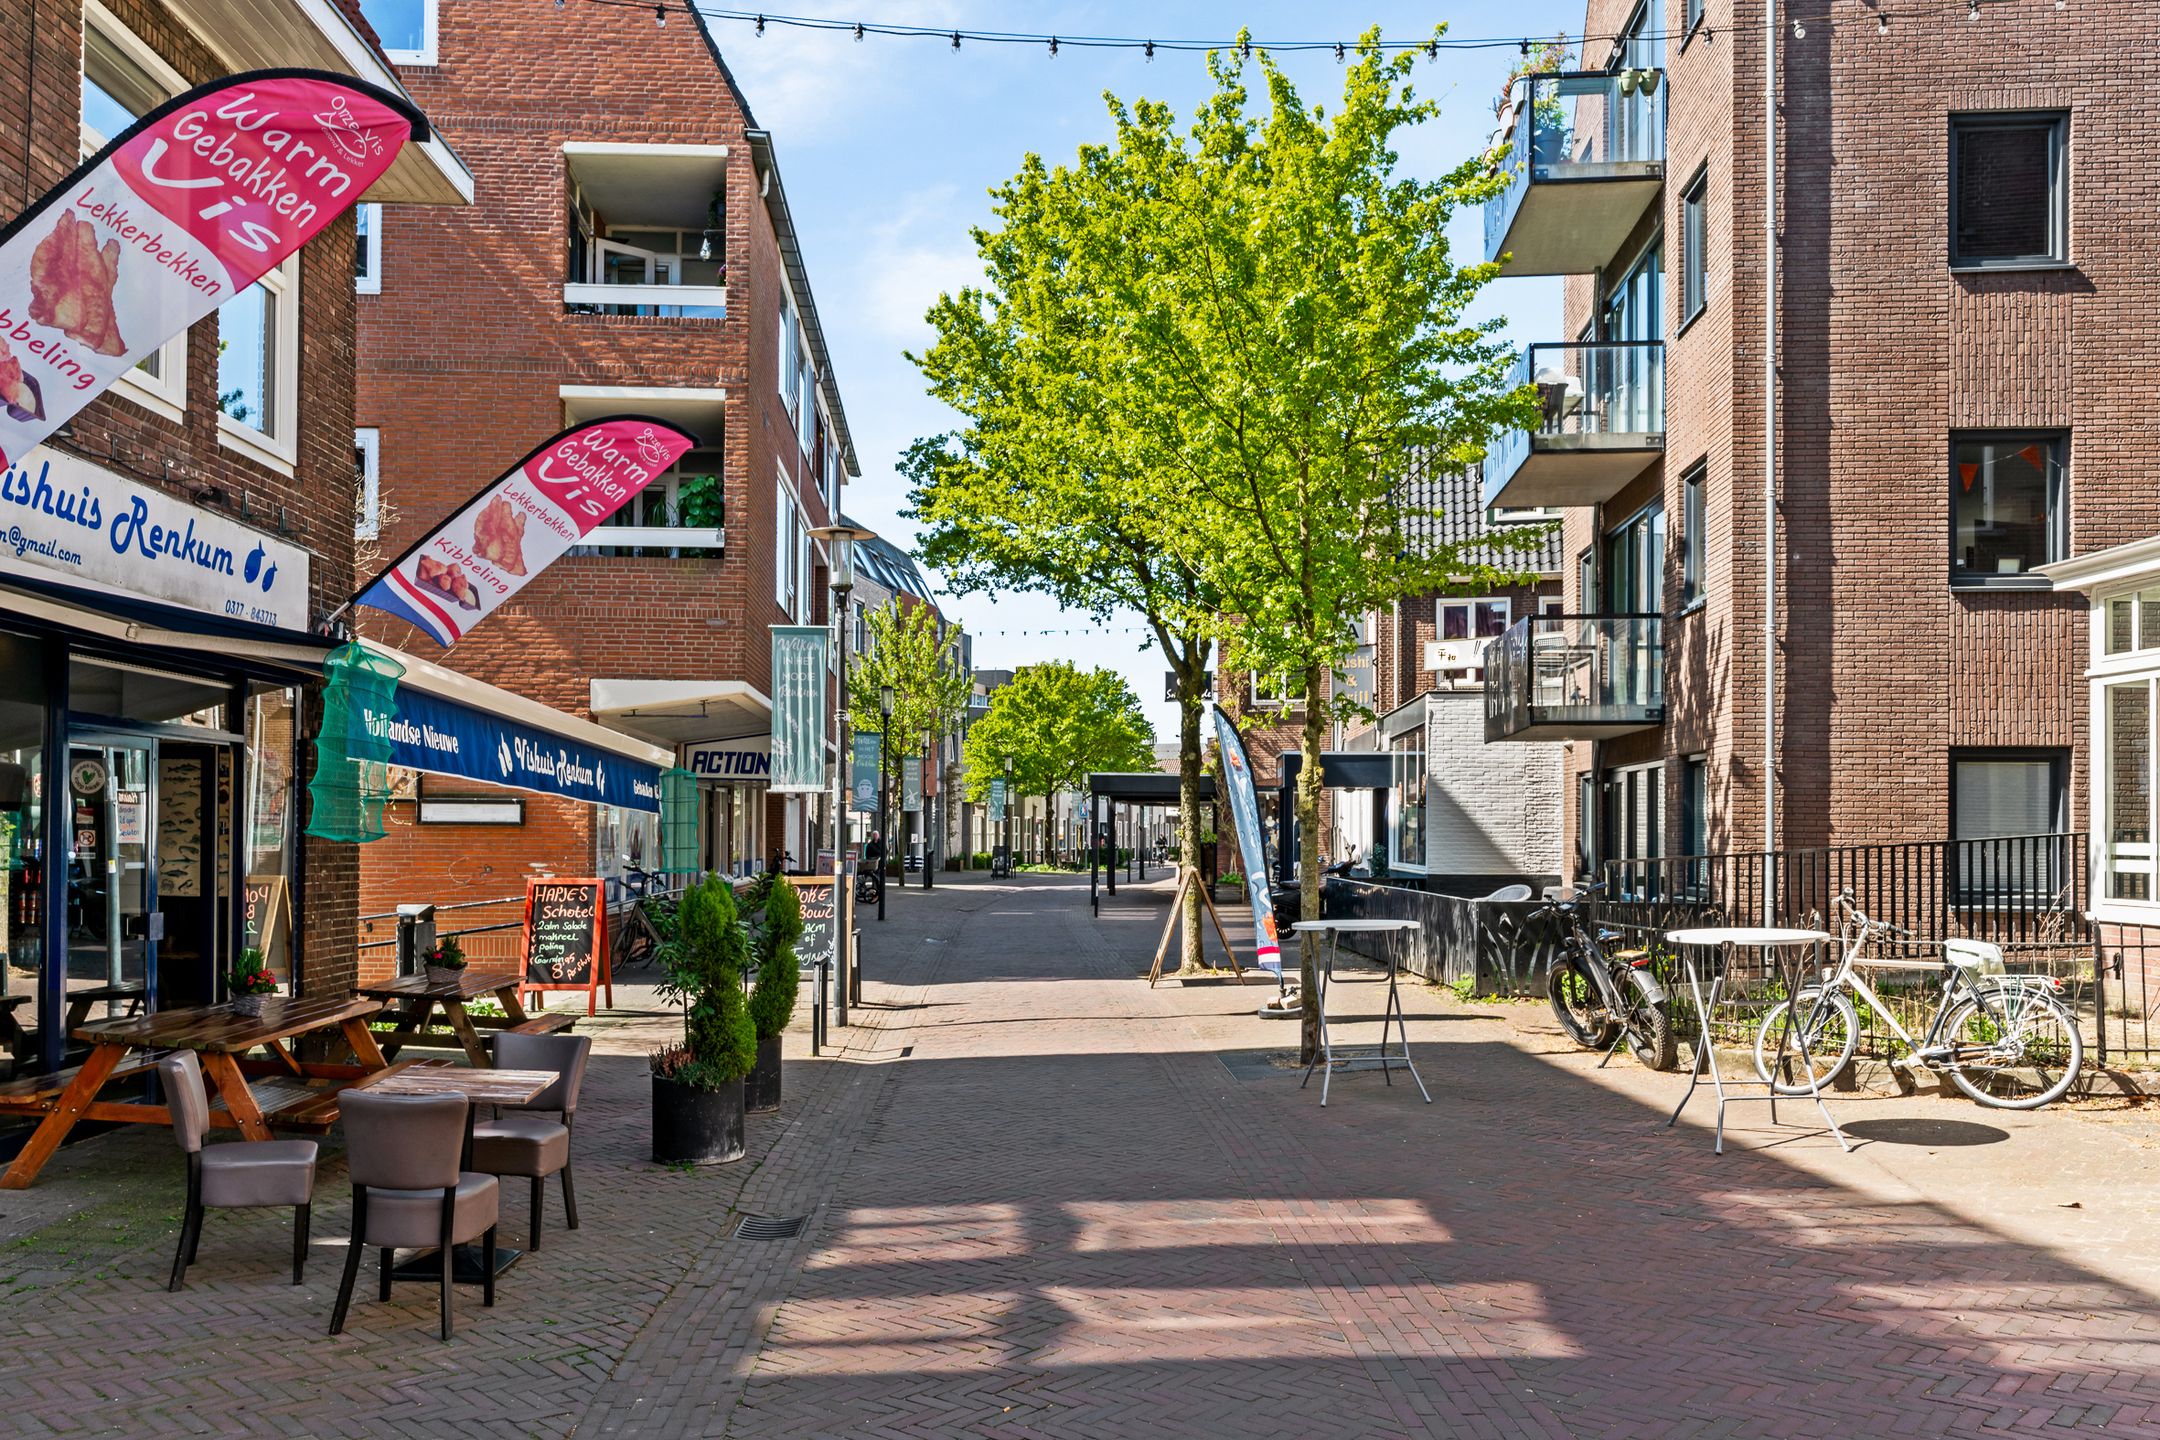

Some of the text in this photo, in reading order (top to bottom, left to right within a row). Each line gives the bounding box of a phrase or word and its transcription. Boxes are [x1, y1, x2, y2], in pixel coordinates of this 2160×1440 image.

[216, 93, 351, 198] Warm
[331, 96, 384, 156] Onze Vis
[141, 138, 281, 253] Vis
[173, 111, 317, 229] Gebakken
[76, 187, 222, 297] Lekkerbekken
[582, 429, 649, 485] Warm
[643, 427, 661, 447] Onze
[538, 456, 606, 517] Vis
[557, 441, 627, 502] Gebakken
[110, 495, 234, 576] Renkum
[503, 482, 575, 542] Lekkerbekken
[433, 537, 509, 594] Kibbeling
[225, 599, 245, 616] 0317
[250, 606, 277, 626] 843713
[1346, 674, 1359, 687] &
[363, 708, 459, 754] Hollandse Nieuwe
[514, 736, 594, 788] Vishuis Renkum
[691, 751, 772, 775] ACTION
[534, 885, 588, 903] HAPJES
[542, 904, 594, 919] Schotel
